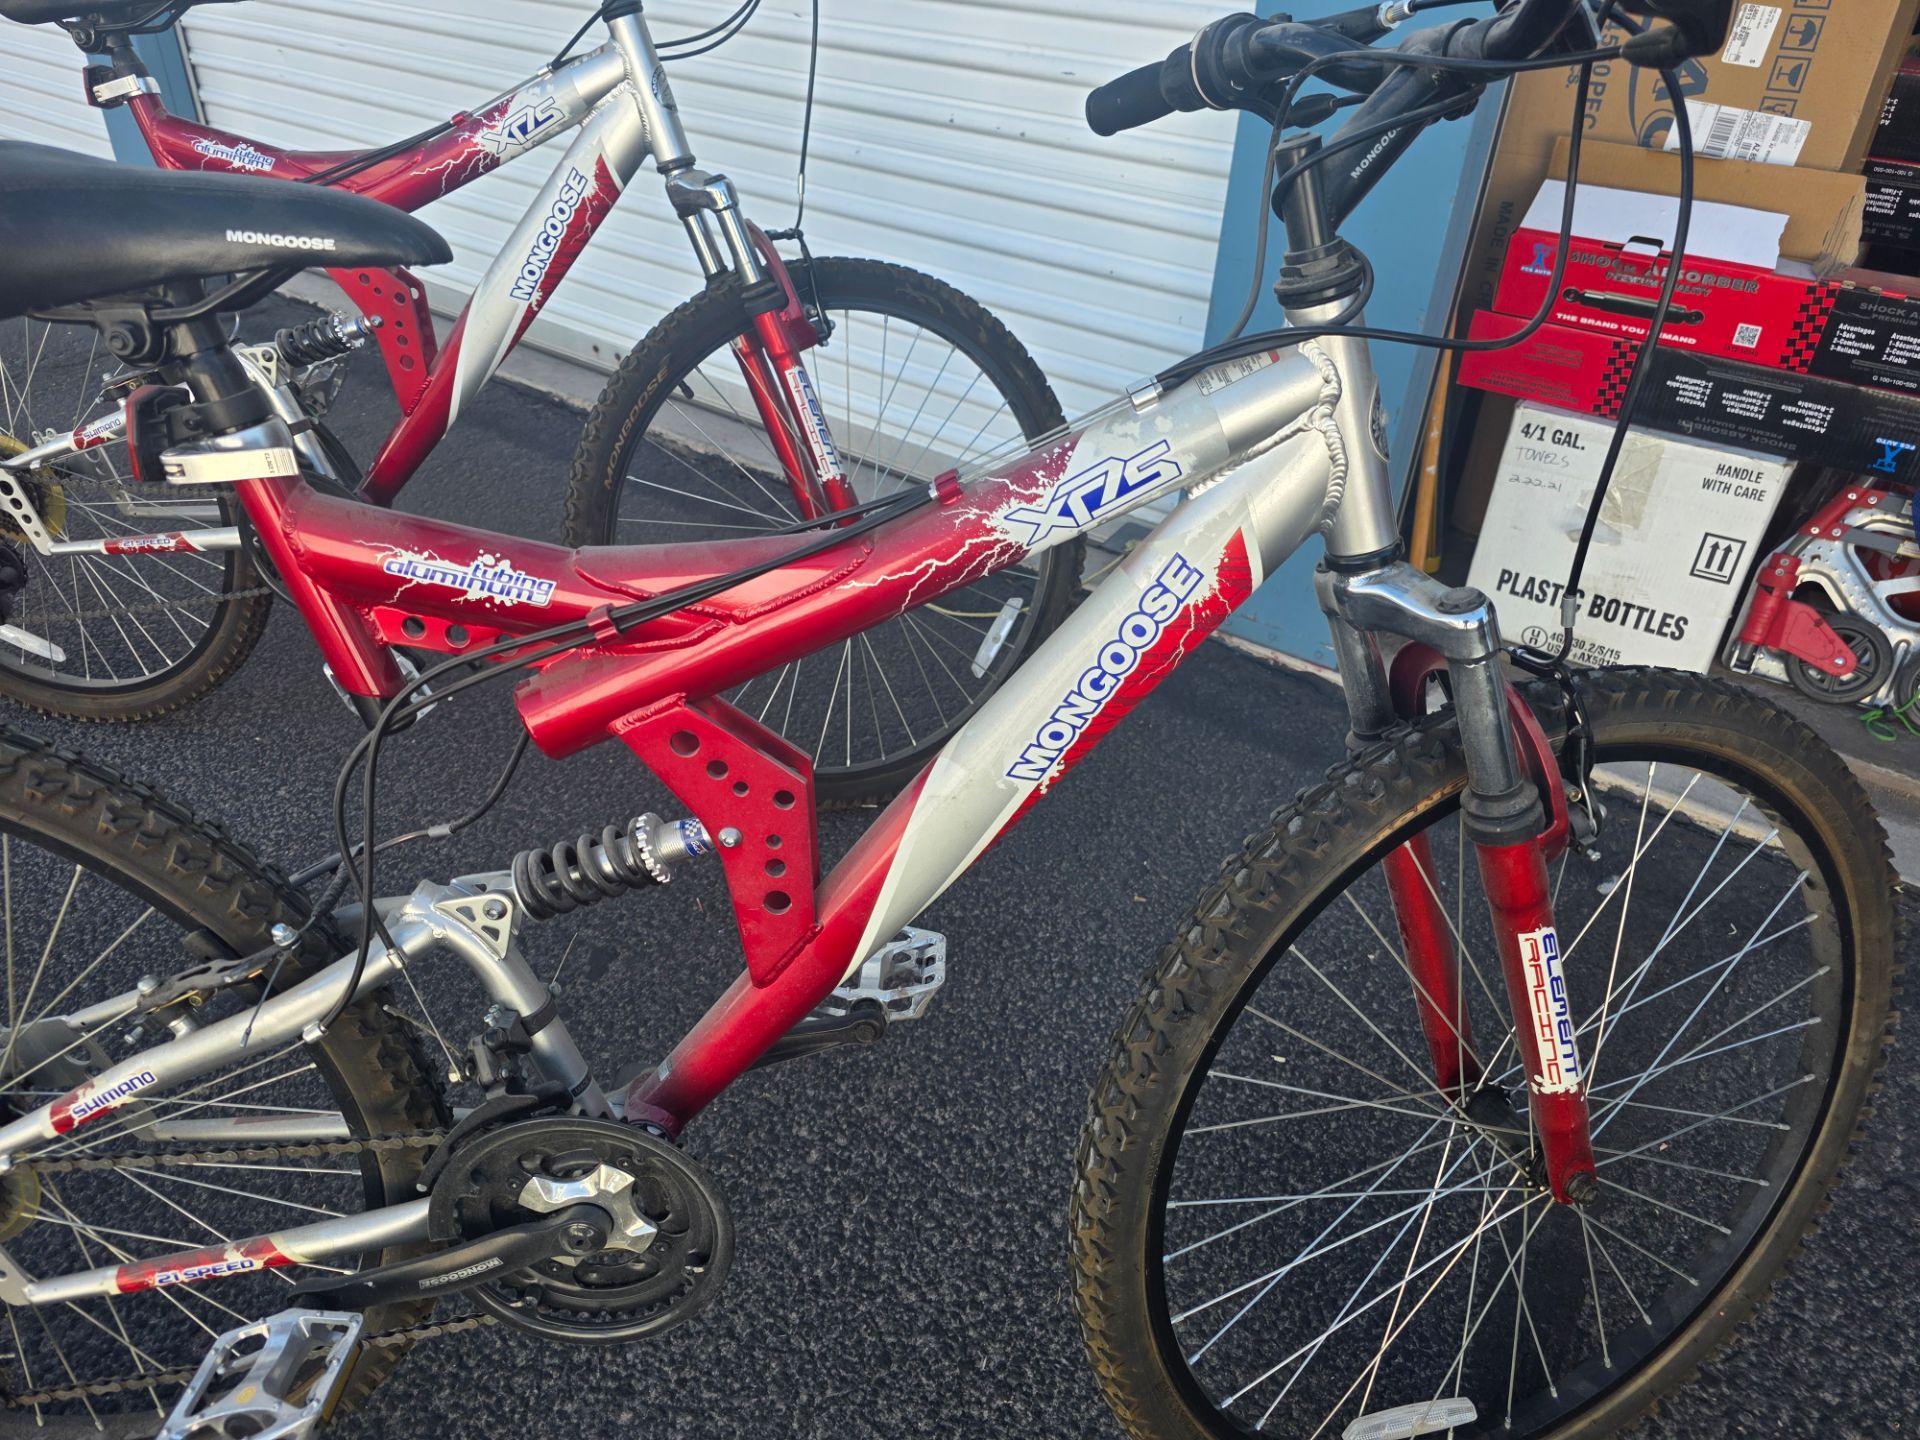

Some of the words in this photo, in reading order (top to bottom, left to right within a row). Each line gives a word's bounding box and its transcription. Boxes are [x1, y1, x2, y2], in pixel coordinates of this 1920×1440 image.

[196, 145, 264, 168] aluminum
[235, 148, 273, 166] tubing
[1350, 127, 1402, 178] MONGOO
[226, 229, 335, 251] MONGOOSE
[510, 167, 588, 301] MONGOOSE
[1662, 281, 1712, 297] ALITY
[1859, 302, 1907, 317] SHOCK
[1556, 312, 1577, 322] THE
[1580, 316, 1618, 330] BRAND
[1621, 324, 1646, 335] YOU
[1647, 330, 1697, 345] MAND
[1835, 330, 1856, 340] 1-Safe
[1838, 323, 1876, 335] Advantages
[1890, 332, 1920, 345] Avantage
[1829, 344, 1860, 356] 3-Reliable
[1832, 337, 1876, 351] 2-Comfortable
[1675, 396, 1706, 408] Ventajas
[1781, 404, 1832, 421] 2-Comfortable
[1797, 400, 1835, 413] 3-Reliable
[788, 370, 831, 475] RACING
[797, 369, 842, 466] ELEMENT
[1695, 416, 1736, 430] QUALITY
[1726, 407, 1764, 421] Avantages
[1804, 416, 1828, 427] 1-Safe
[83, 418, 121, 439] SHIMANO
[1520, 423, 1546, 443] 4/1
[1551, 428, 1585, 451] GAL.
[1738, 424, 1784, 440] PREMIUM
[1782, 419, 1826, 434] Advantages
[1750, 435, 1797, 451] SHOCK
[1876, 437, 1898, 447] AUTO
[1716, 463, 1764, 484] HANDLE
[1702, 478, 1731, 496] WITH
[1734, 486, 1767, 502] CARE
[132, 538, 171, 546] SPEED
[385, 559, 535, 601] aluminum
[472, 563, 554, 597] tubing
[1496, 568, 1586, 613] PLASTC
[1588, 594, 1689, 641] BOTTLES
[1006, 553, 1205, 781] MONGOOSE
[1523, 937, 1562, 1086] RACING
[1542, 932, 1579, 1078] ELEMENT
[72, 1071, 156, 1119] SHIMANO
[158, 1272, 180, 1285] 21
[183, 1259, 255, 1280] SPEED
[419, 1257, 504, 1289] MONGOOSE
